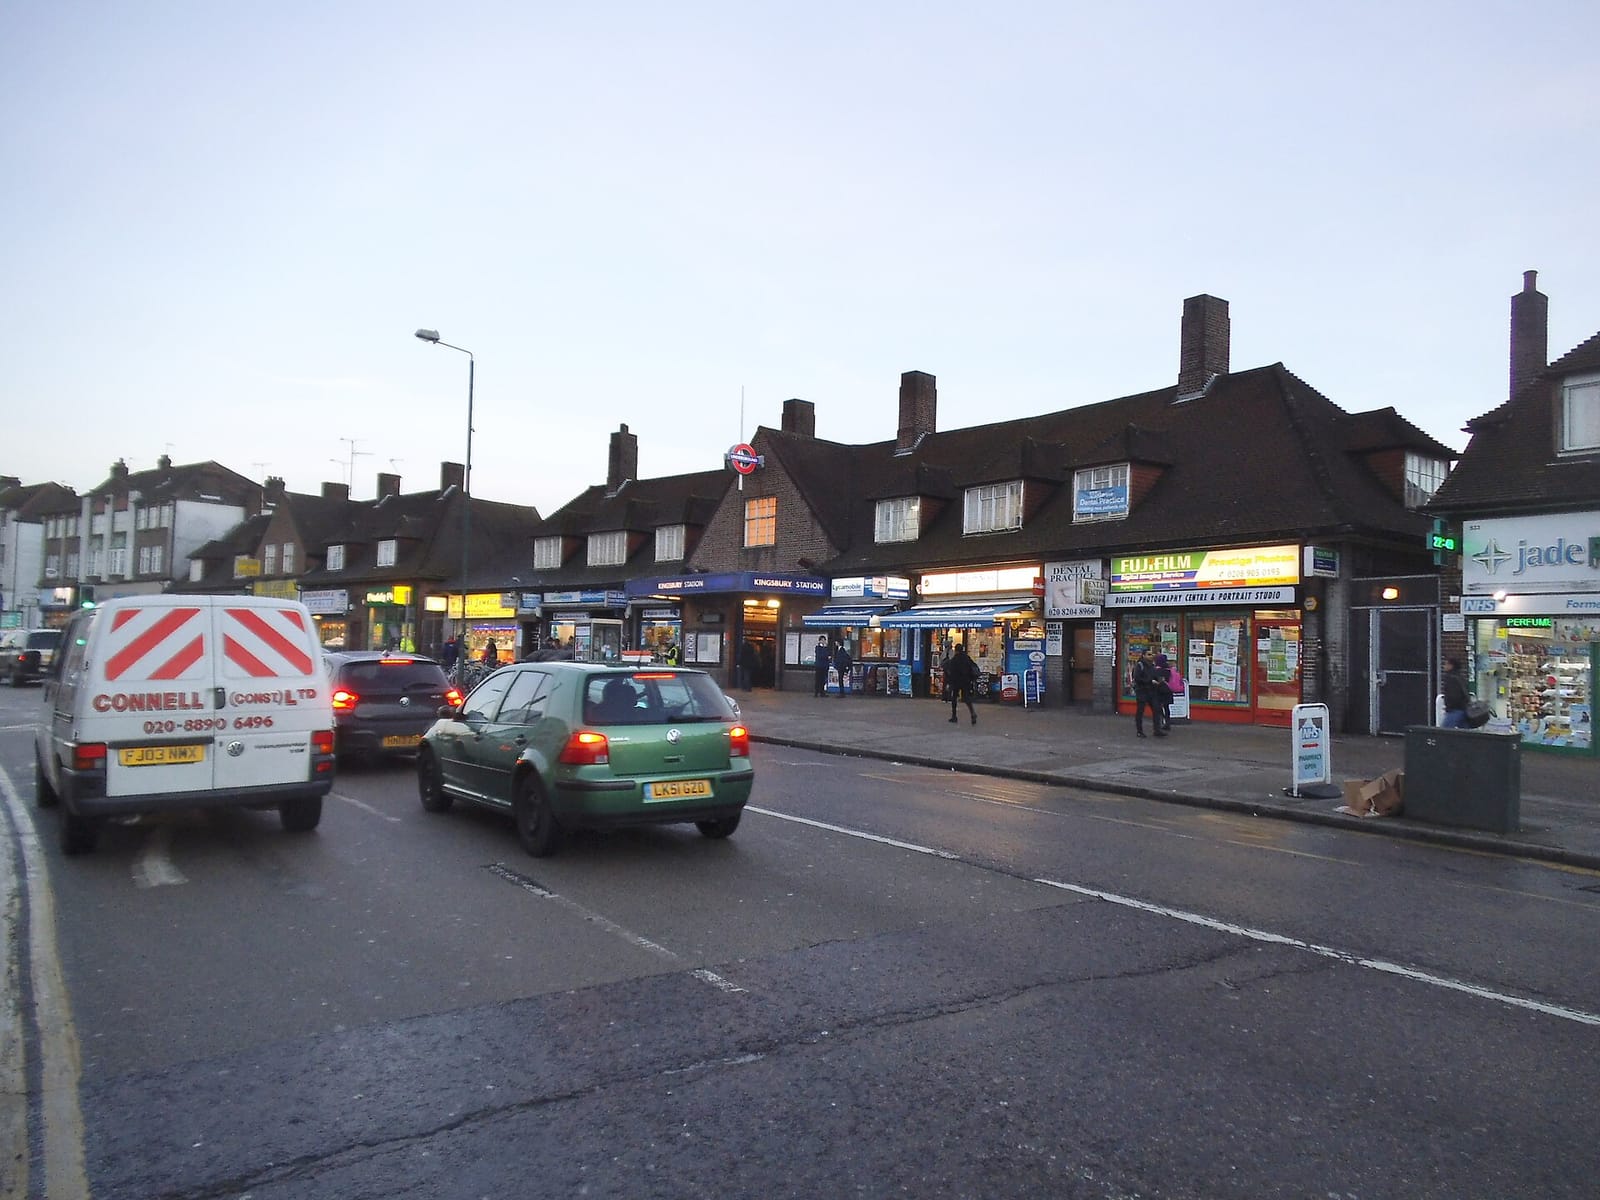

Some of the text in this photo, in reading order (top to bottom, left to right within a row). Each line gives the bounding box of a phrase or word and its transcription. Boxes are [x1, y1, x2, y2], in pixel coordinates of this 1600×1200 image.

[1512, 537, 1585, 576] jade
[1121, 556, 1191, 572] FUJIFILM
[1053, 565, 1091, 575] DENTAL
[1050, 572, 1096, 582] PRACTICE
[1121, 573, 1139, 581] Digital
[1140, 572, 1162, 580] Imaging
[684, 580, 703, 588] STATION
[753, 578, 823, 590] KINGSBURY STATION
[832, 583, 862, 591] Lycamobile
[1115, 596, 1136, 604] DIGITAL
[1139, 594, 1182, 603] PHOTOGRAPHY
[1185, 593, 1207, 602] CENTRE
[1210, 593, 1215, 601] &
[1218, 592, 1252, 601] PORTRAIT
[1255, 591, 1281, 600] STUDIO
[1465, 600, 1494, 611] NHS
[1048, 608, 1060, 616] 020
[1061, 608, 1078, 616] 8204
[1507, 618, 1552, 626] PERFUME
[92, 688, 317, 713] CONNELL (CONST) LTD
[143, 715, 274, 735] 020-8890 6496
[1302, 726, 1320, 740] NHS
[124, 747, 164, 763] FJ03
[1298, 754, 1322, 762] PHARMACY
[654, 783, 680, 797] LK51
